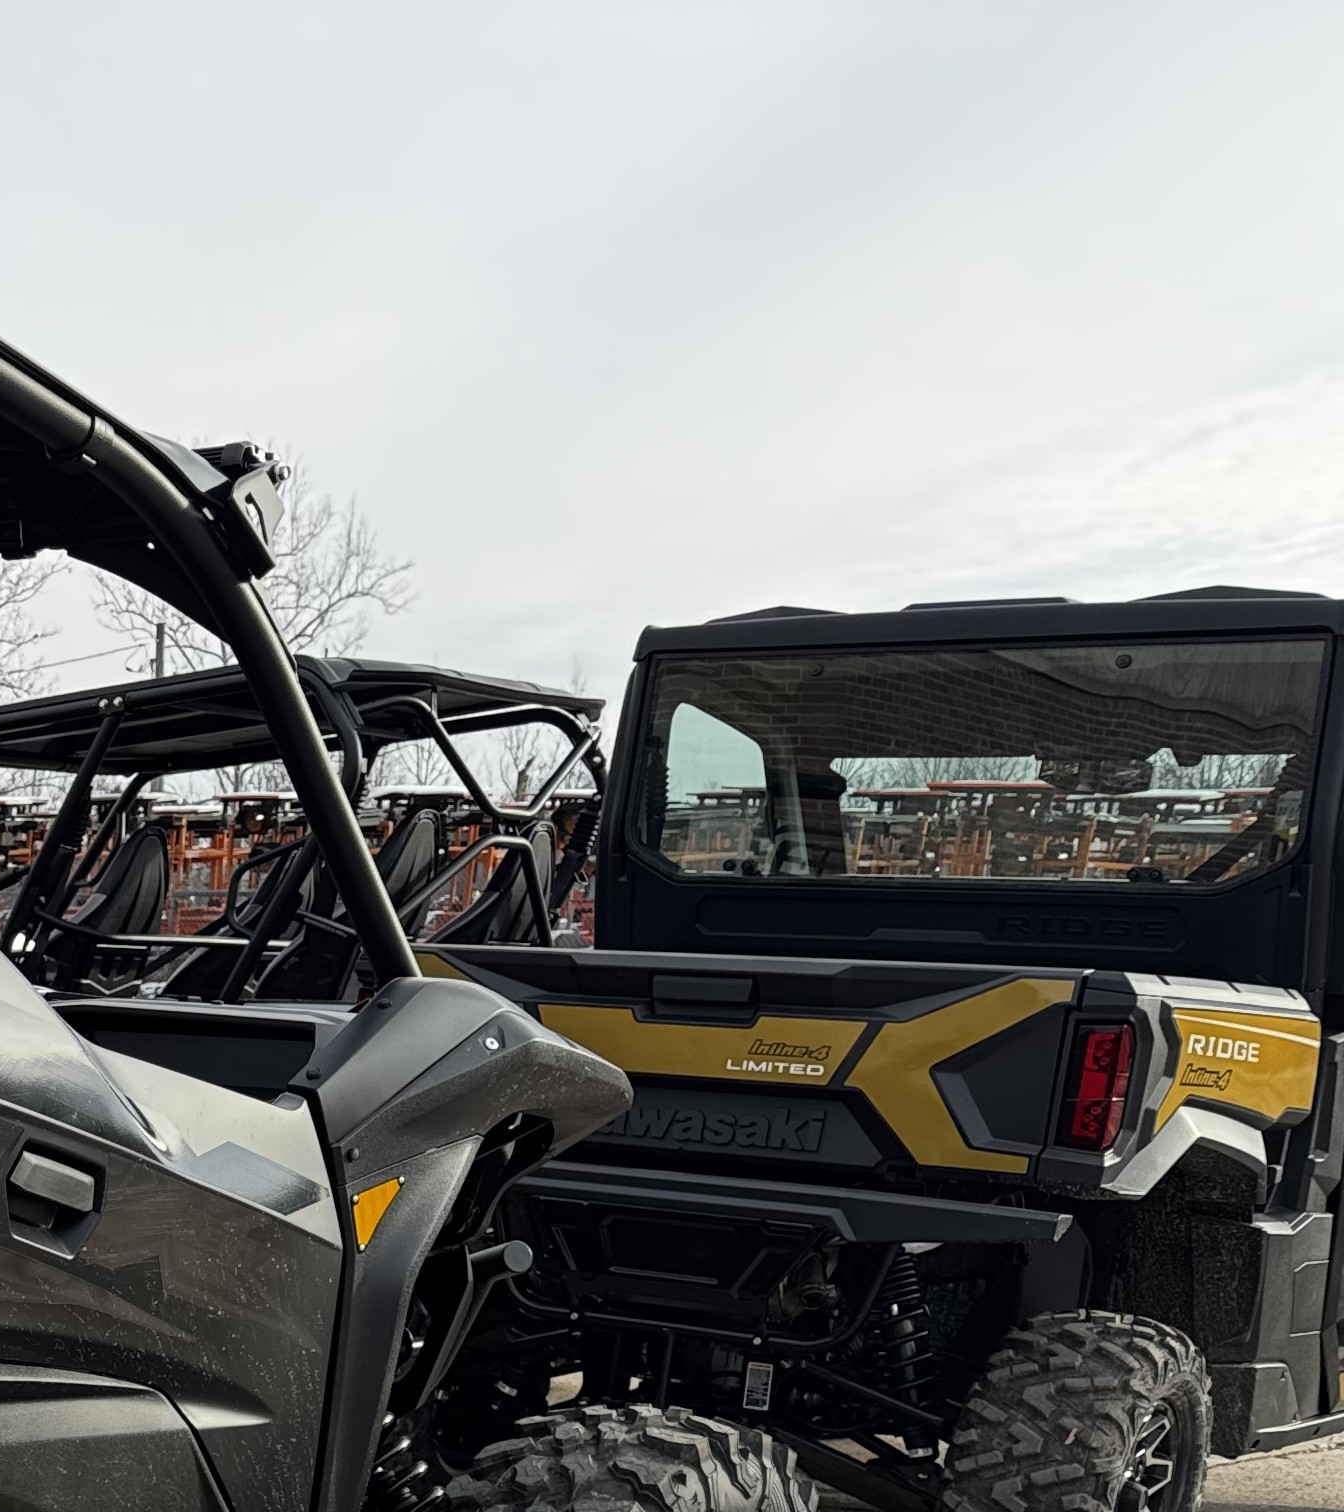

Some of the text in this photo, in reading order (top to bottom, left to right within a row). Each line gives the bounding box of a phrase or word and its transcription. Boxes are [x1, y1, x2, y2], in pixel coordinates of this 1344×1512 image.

[998, 914, 1169, 938] RIDGE
[748, 1039, 831, 1061] Inline-4
[1187, 1033, 1261, 1063] RIDGE
[726, 1059, 825, 1076] LIMITED
